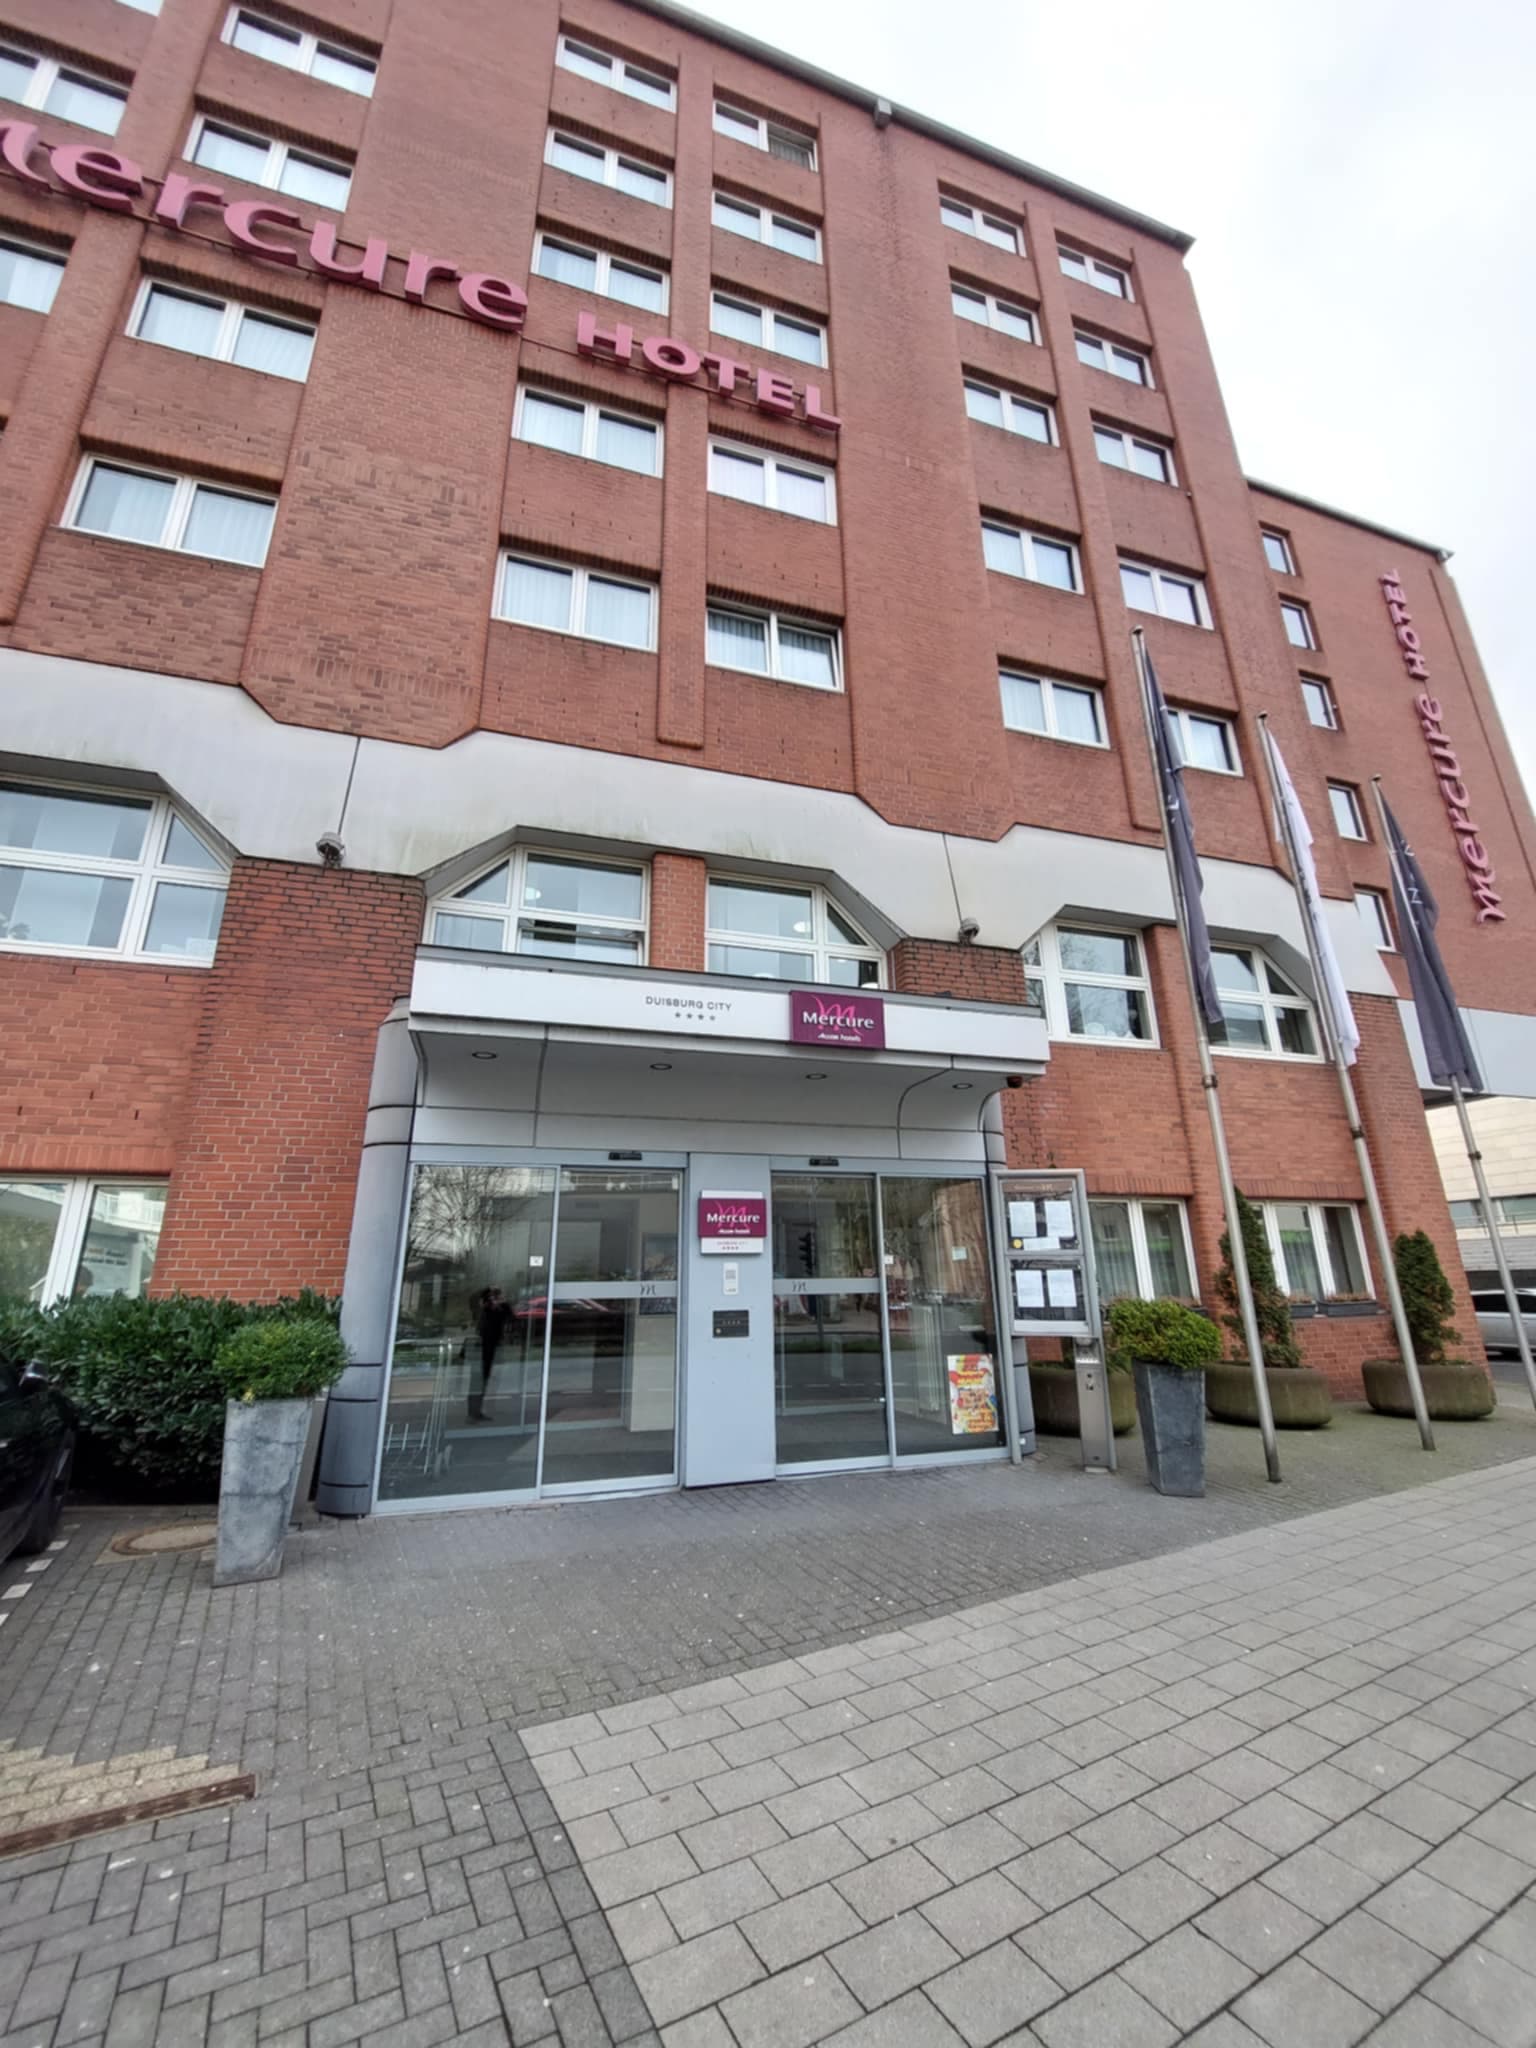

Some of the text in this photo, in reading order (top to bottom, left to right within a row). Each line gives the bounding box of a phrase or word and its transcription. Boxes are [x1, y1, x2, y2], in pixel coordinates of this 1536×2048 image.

[576, 310, 842, 431] HOTEL
[1378, 567, 1431, 682] HOTEL
[645, 995, 732, 1012] DUISBURG CITY
[802, 1010, 875, 1030] Mercure
[706, 1212, 760, 1225] Mercure
